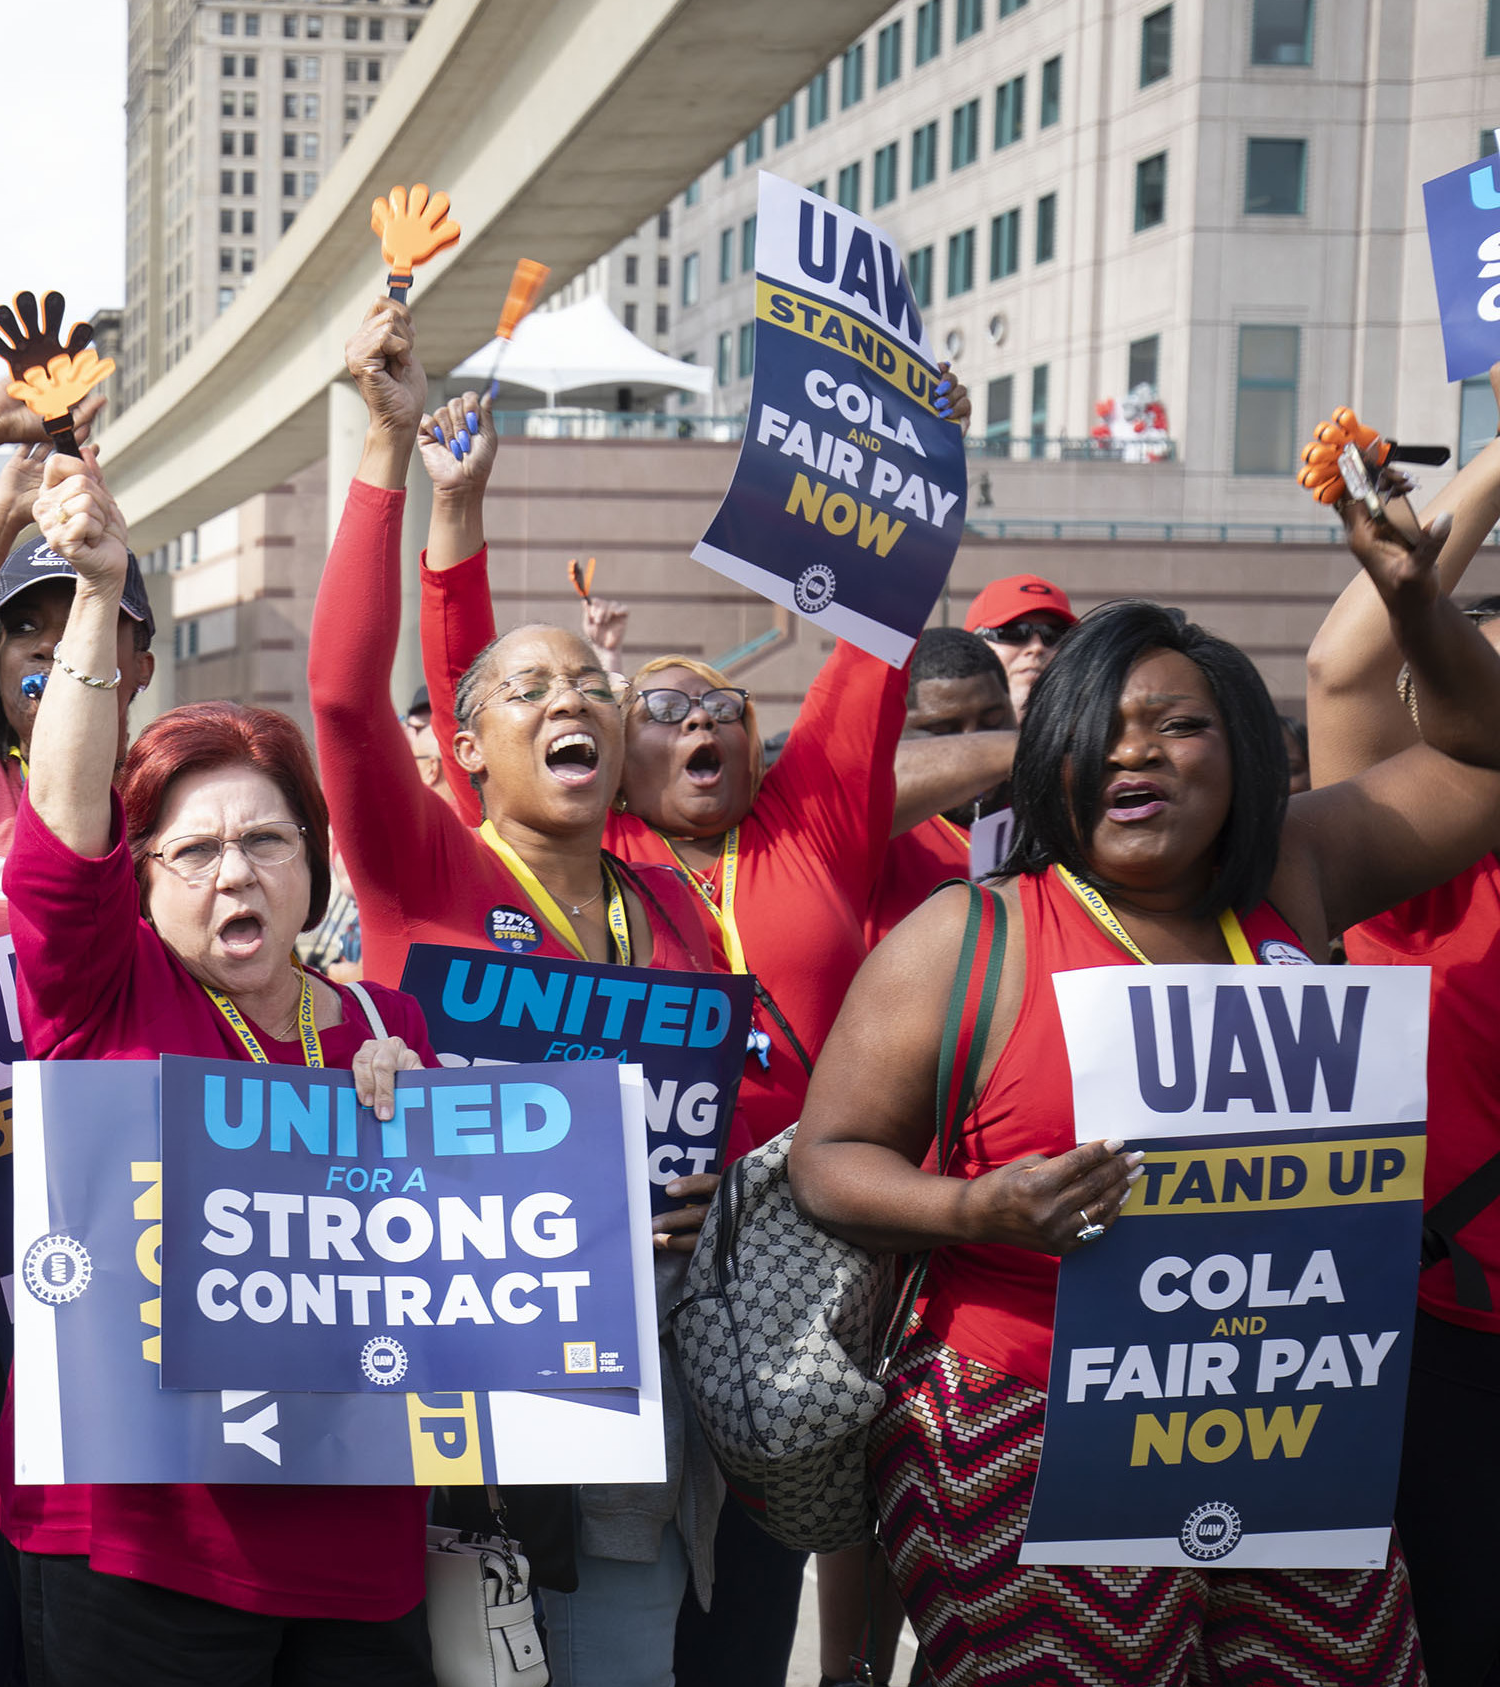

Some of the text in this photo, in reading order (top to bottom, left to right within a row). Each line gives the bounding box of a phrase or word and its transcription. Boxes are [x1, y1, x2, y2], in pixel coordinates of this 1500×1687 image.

[798, 199, 924, 346] UAW
[770, 293, 897, 375] STAND
[804, 368, 927, 458] COLA
[847, 427, 882, 453] AND
[757, 403, 960, 529] FAIR PAY
[784, 473, 907, 560] NOW
[492, 910, 534, 928] 97%
[493, 924, 522, 932] READY
[494, 930, 537, 942] STRIKE
[611, 908, 623, 930] THE
[221, 1000, 243, 1026] THE
[442, 959, 731, 1049] UNITED
[301, 1025, 320, 1068] STRONG
[543, 1041, 604, 1062] FOR
[1128, 985, 1369, 1113] UAW
[204, 1074, 571, 1158] UNITED
[325, 1166, 427, 1192] FOR A
[1141, 1148, 1406, 1206] TAND UP
[201, 1188, 578, 1263] STRONG
[196, 1268, 590, 1326] CONTRACT
[1139, 1250, 1345, 1313] COLA
[1210, 1315, 1267, 1338] AND
[373, 1355, 394, 1366] UAW
[600, 1365, 624, 1373] FIGHT
[1066, 1331, 1400, 1403] FAIR PAY
[1129, 1404, 1323, 1467] NOW
[1199, 1524, 1224, 1536] UAW
